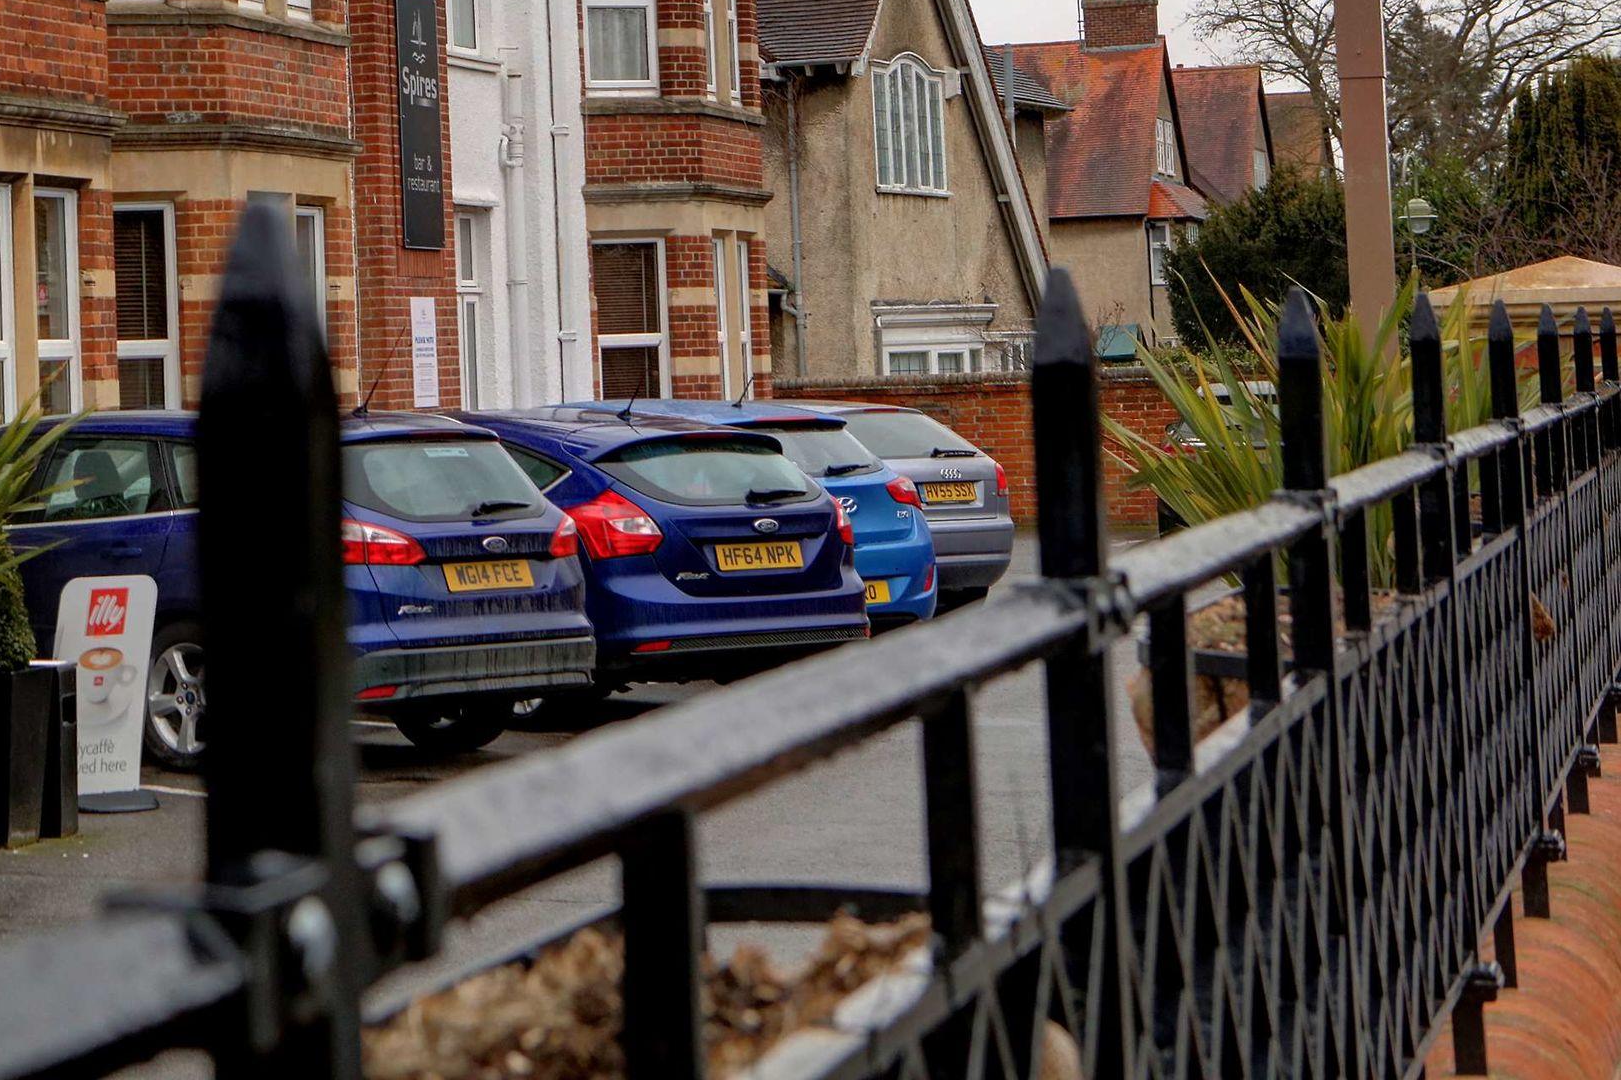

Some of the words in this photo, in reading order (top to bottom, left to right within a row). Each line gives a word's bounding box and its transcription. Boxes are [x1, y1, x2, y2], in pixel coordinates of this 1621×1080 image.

[402, 65, 437, 105] Spires
[414, 152, 425, 171] bar
[427, 155, 432, 172] &
[408, 176, 440, 192] restaurant
[926, 482, 953, 499] HV55
[722, 546, 763, 566] HF64
[766, 545, 796, 564] NPK
[454, 564, 491, 585] WG14
[492, 562, 523, 583] FCE
[90, 594, 125, 631] illy
[78, 738, 115, 759] ycaffè
[100, 758, 127, 773] here
